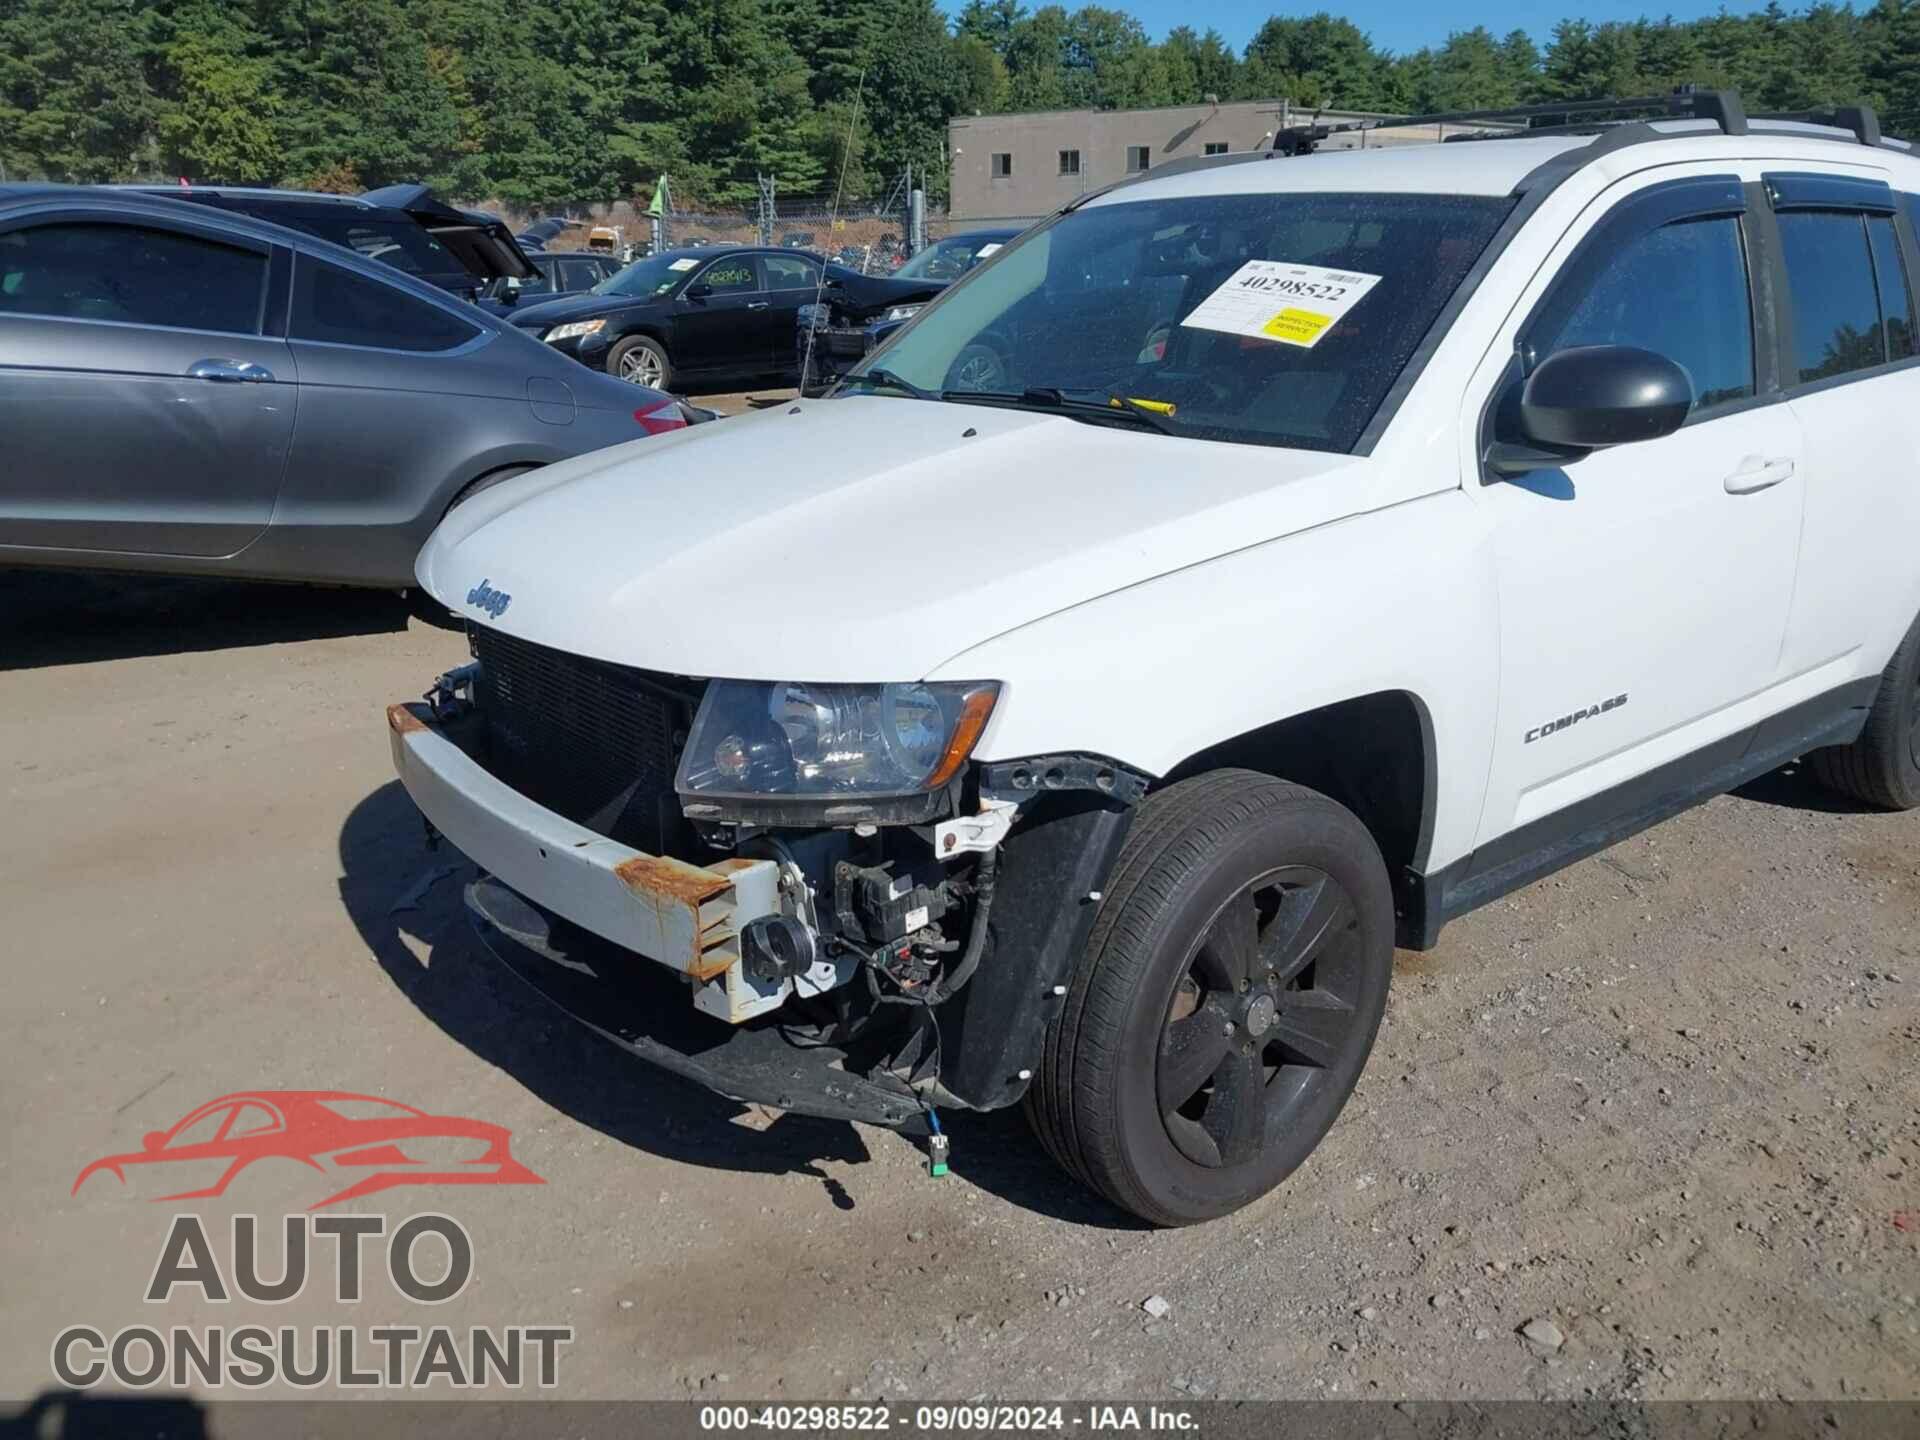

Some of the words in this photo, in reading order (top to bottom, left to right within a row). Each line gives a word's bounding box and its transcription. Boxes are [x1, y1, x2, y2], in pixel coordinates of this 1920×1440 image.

[1240, 275, 1346, 301] 40298522
[467, 578, 511, 619] Jeep
[1524, 693, 1628, 744] COMPASS
